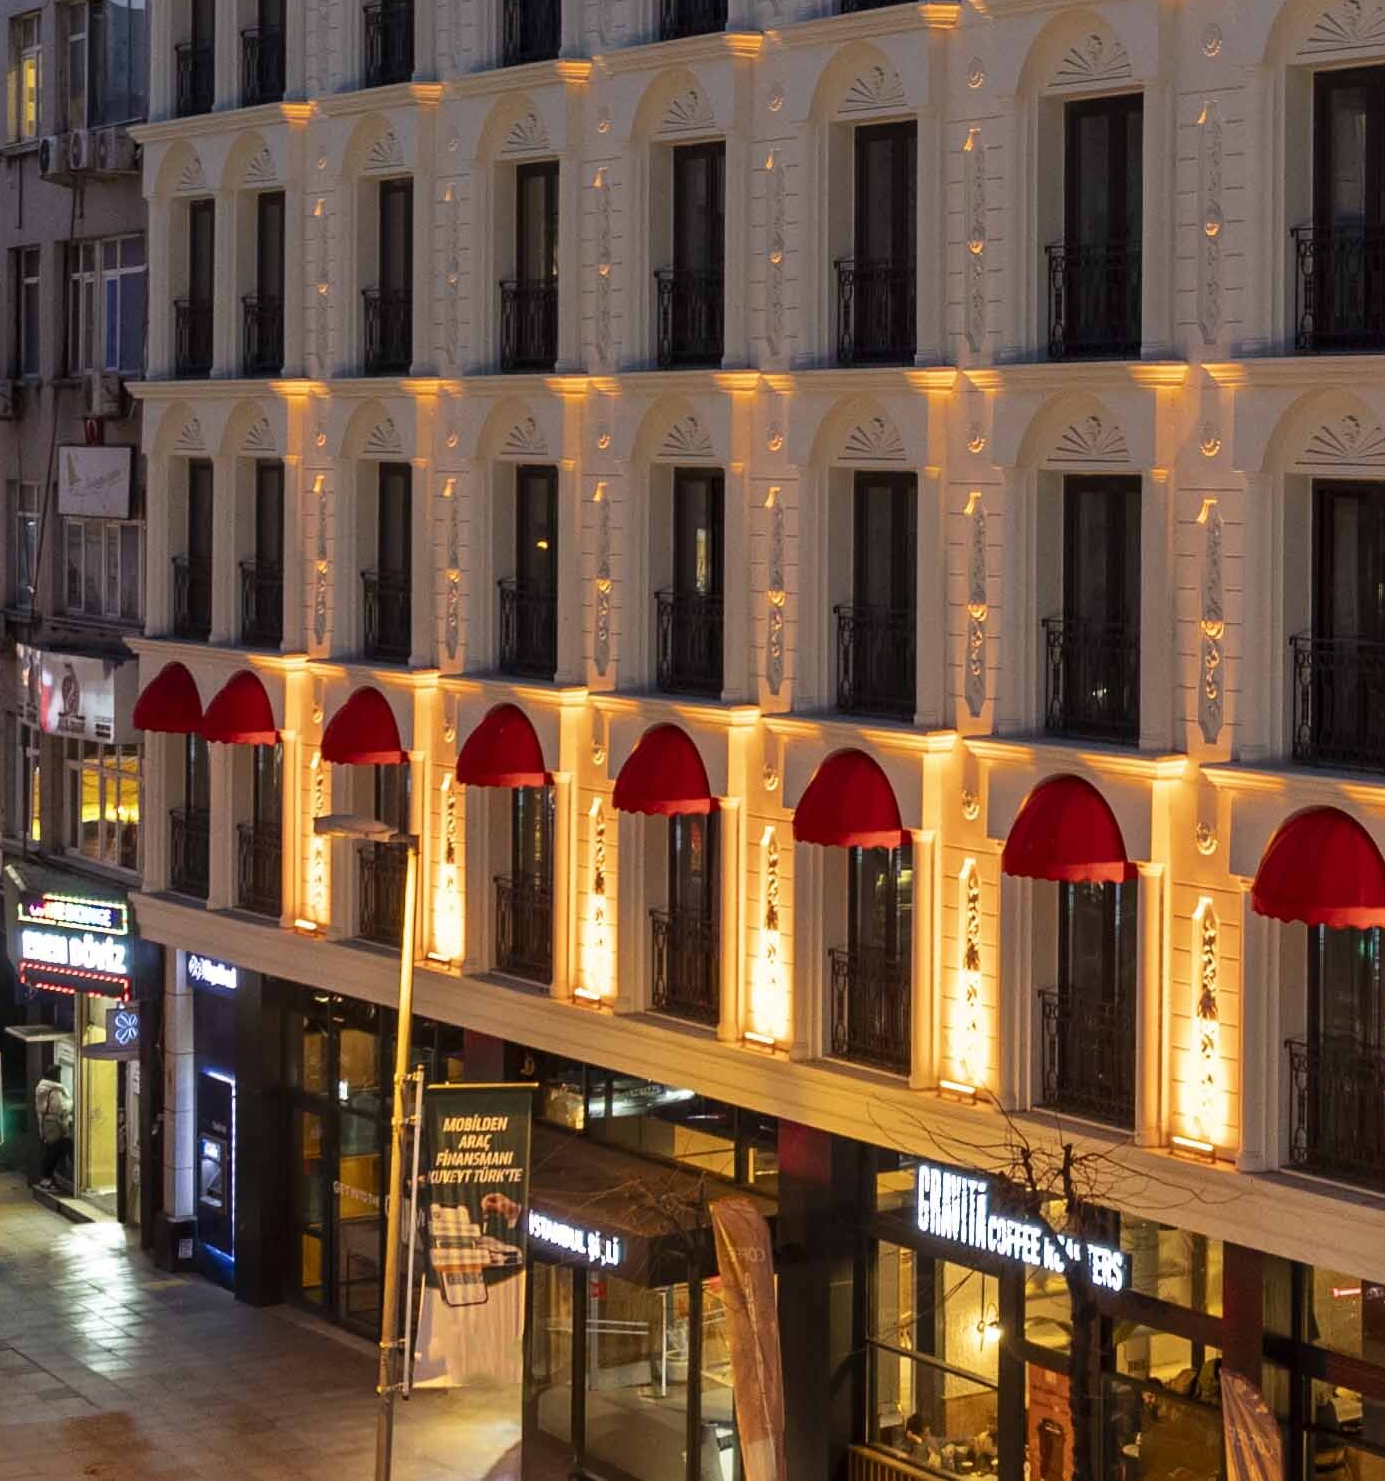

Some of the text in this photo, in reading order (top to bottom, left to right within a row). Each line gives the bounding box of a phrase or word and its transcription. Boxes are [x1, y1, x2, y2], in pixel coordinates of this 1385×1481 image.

[443, 1114, 508, 1132] MOBİLDEN
[458, 1135, 492, 1151] ARAÇ
[435, 1149, 514, 1167] FİNANSMANI
[474, 1166, 523, 1183] TÜRK'TE
[588, 1230, 619, 1266] ŞİLİ
[987, 1215, 1043, 1266] COFFEE
